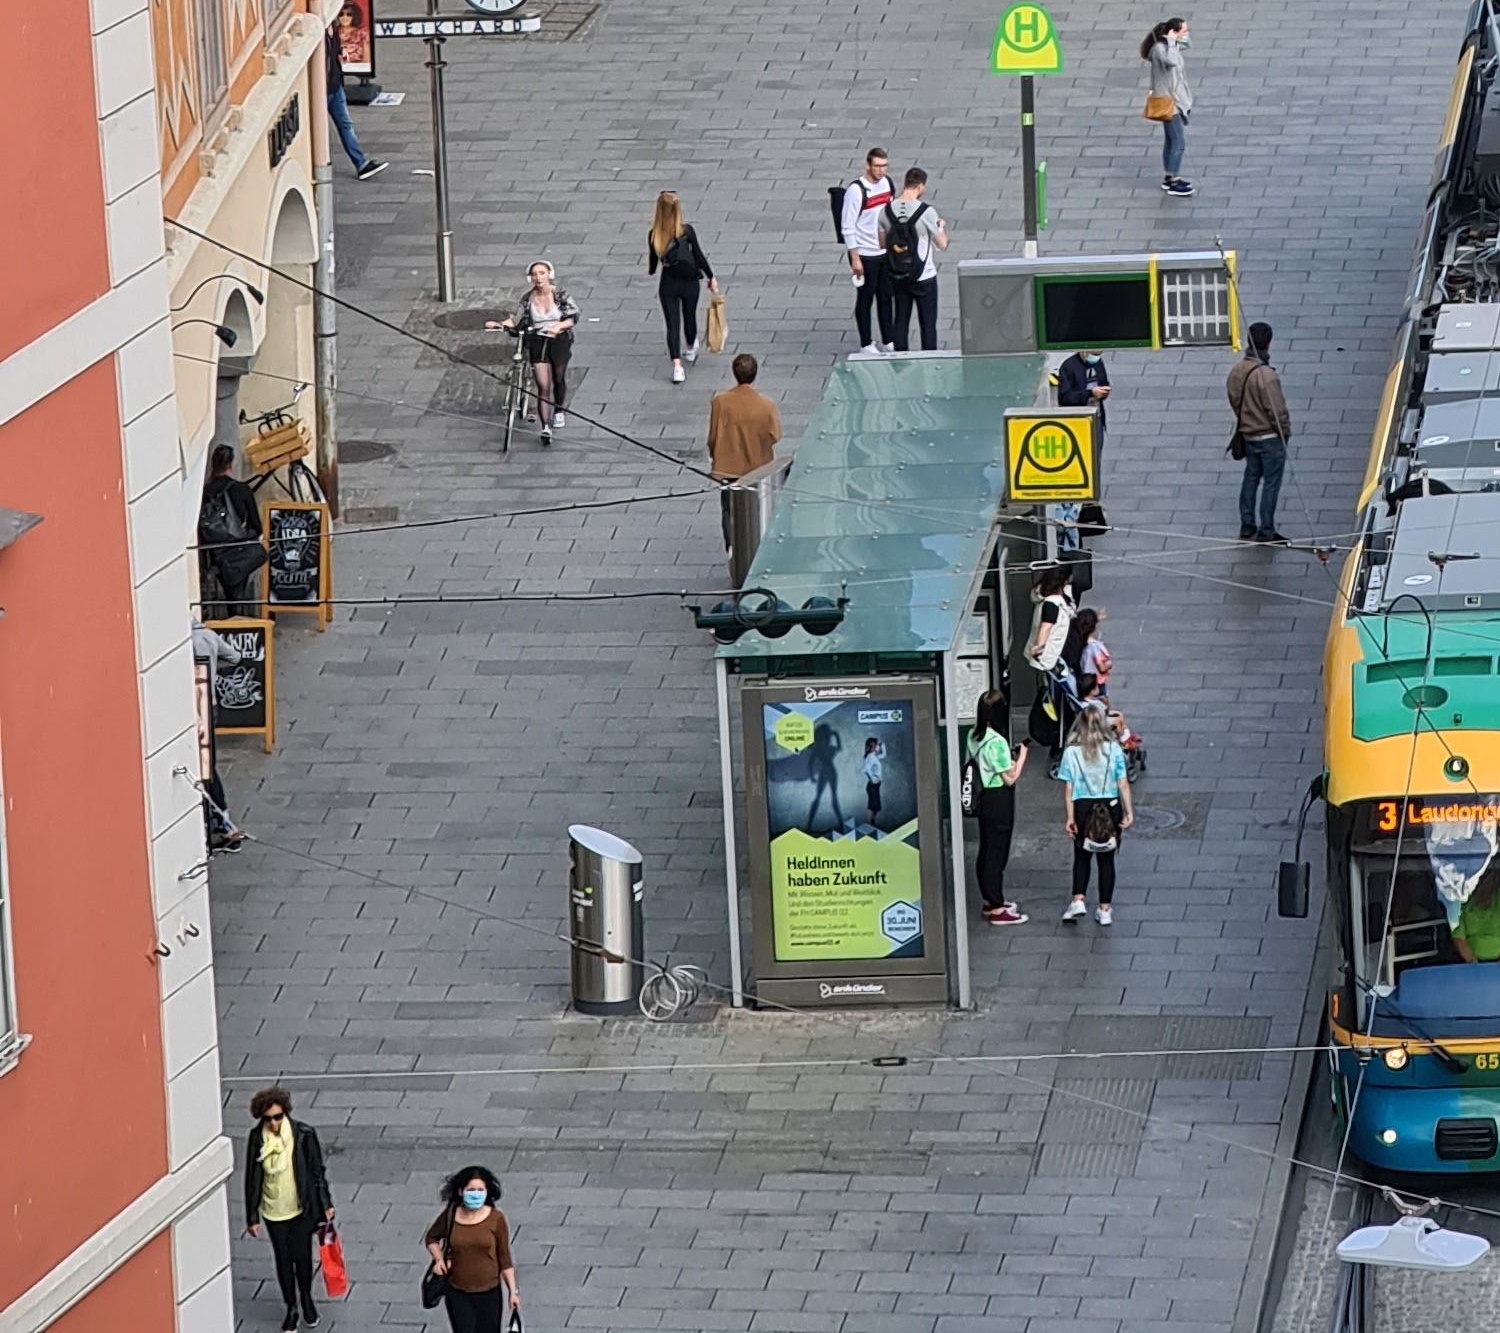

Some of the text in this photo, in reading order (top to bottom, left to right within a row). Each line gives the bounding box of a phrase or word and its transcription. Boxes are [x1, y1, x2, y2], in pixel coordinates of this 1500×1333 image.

[380, 19, 523, 35] WEIKHARD
[1014, 12, 1038, 43] H
[1033, 435, 1067, 459] HH
[1378, 801, 1397, 831] 3
[787, 857, 855, 870] HeldInnen
[787, 872, 888, 887] haben Zukunft
